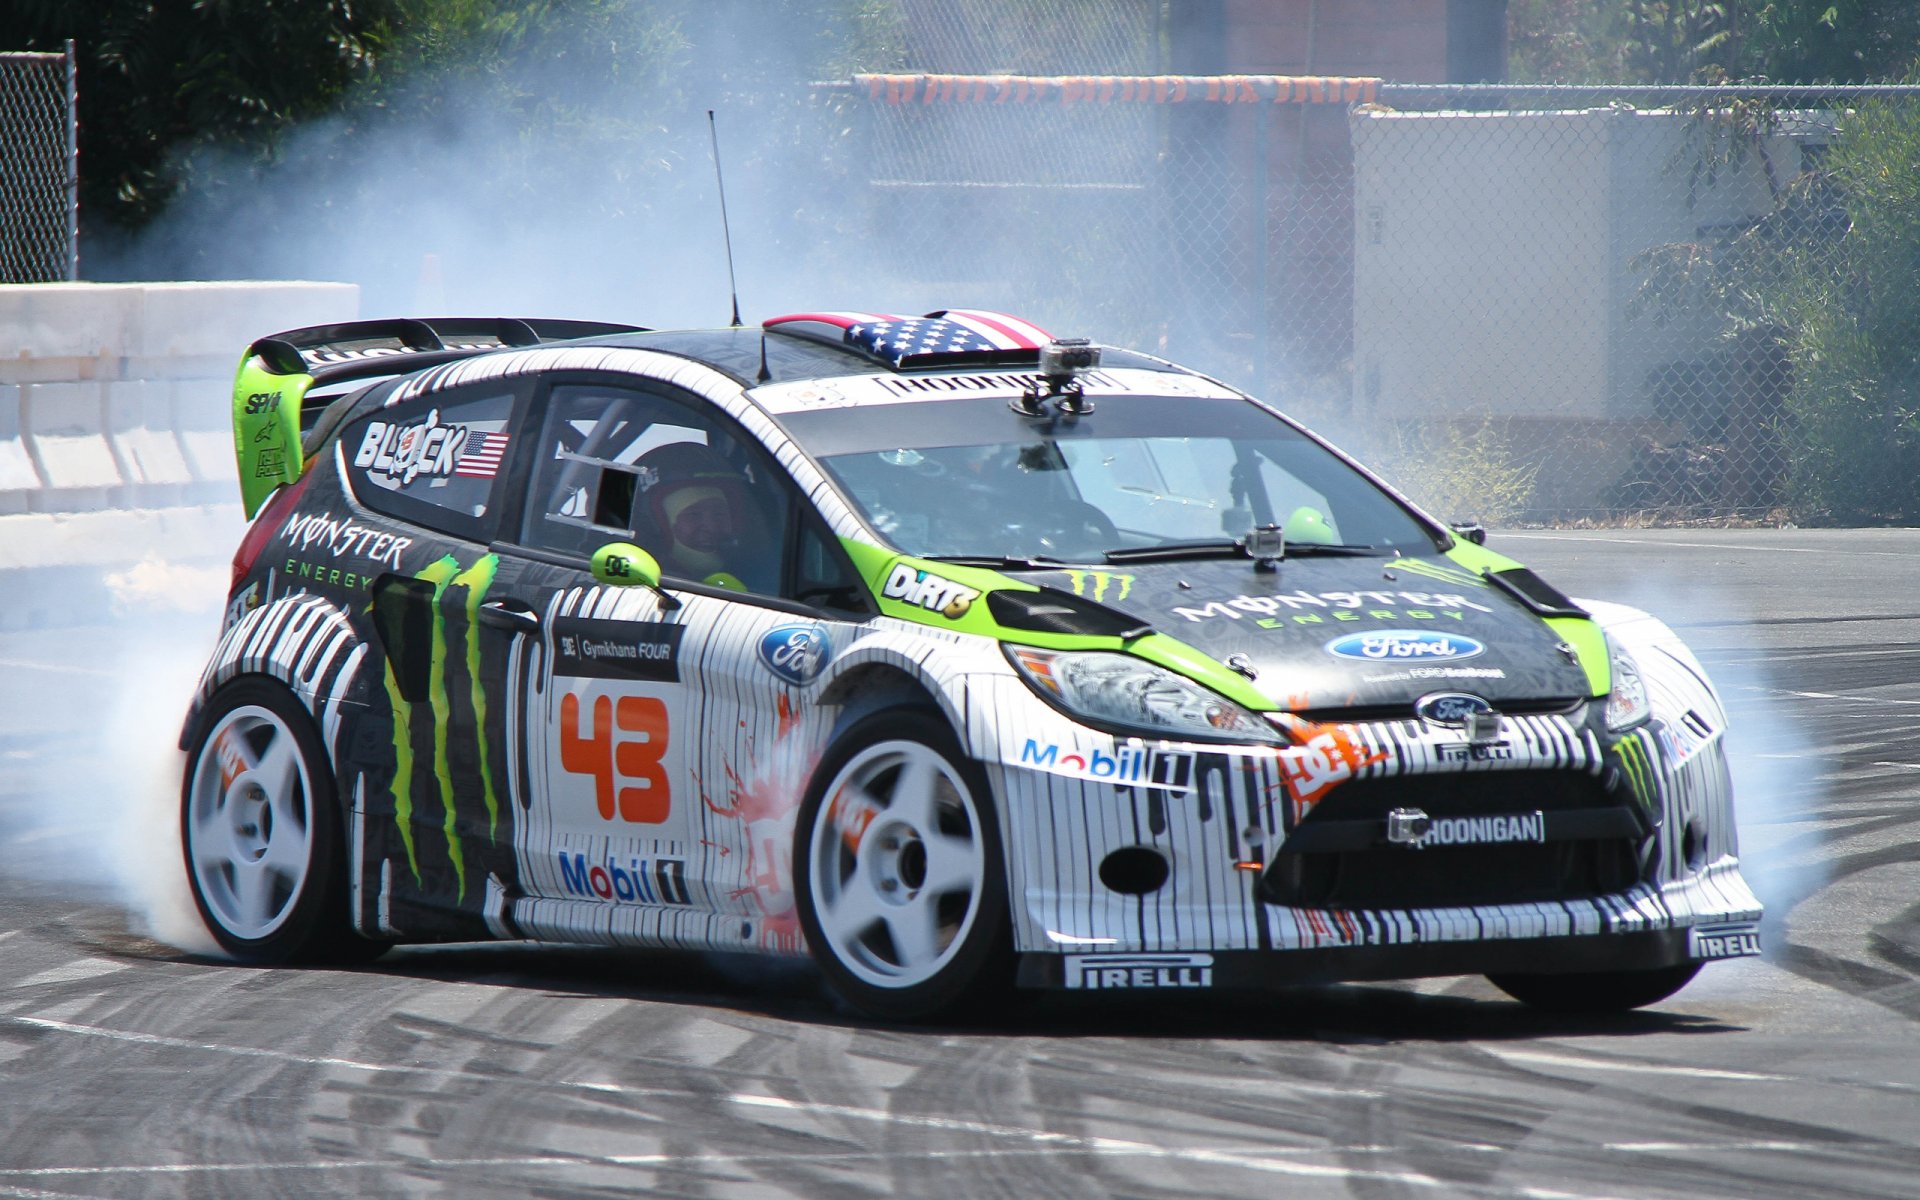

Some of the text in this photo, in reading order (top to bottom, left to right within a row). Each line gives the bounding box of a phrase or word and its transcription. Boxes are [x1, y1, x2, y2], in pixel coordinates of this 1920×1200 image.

[285, 559, 373, 591] ENERGY
[1256, 609, 1465, 630] ENERGY
[582, 640, 637, 660] Gymkhana
[639, 642, 672, 660] FOUR
[1361, 634, 1457, 659] Ford
[1436, 698, 1476, 719] Ford
[560, 691, 672, 826] 43
[558, 851, 657, 904] Mobil
[1064, 953, 1215, 989] PIRELLI
